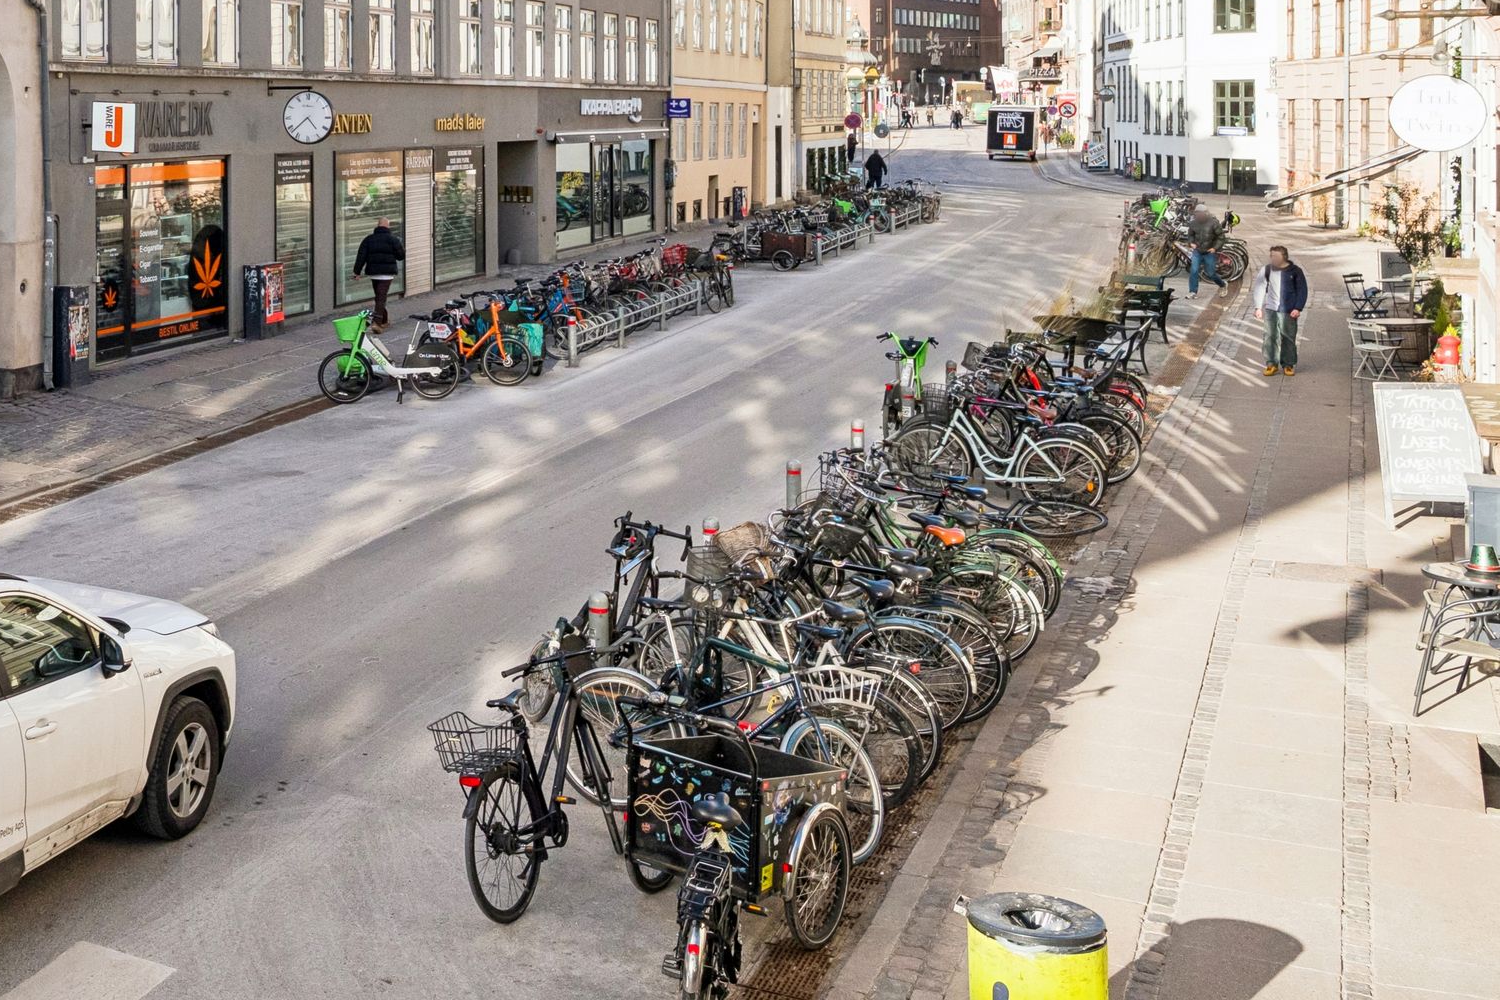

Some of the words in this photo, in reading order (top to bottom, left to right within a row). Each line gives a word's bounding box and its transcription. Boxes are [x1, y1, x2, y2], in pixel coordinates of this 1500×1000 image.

[1029, 67, 1056, 77] PIZZA
[105, 106, 123, 148] J
[137, 101, 214, 138] WARE.DK
[331, 113, 373, 134] ANTEN
[435, 114, 464, 132] mads
[465, 113, 486, 131] laier
[1089, 144, 1105, 156] FREE
[1090, 155, 1106, 167] TEST
[159, 325, 178, 338] BESTIL
[178, 320, 199, 333] ONLINE
[370, 348, 388, 367] Lime
[0, 826, 14, 839] Pelby
